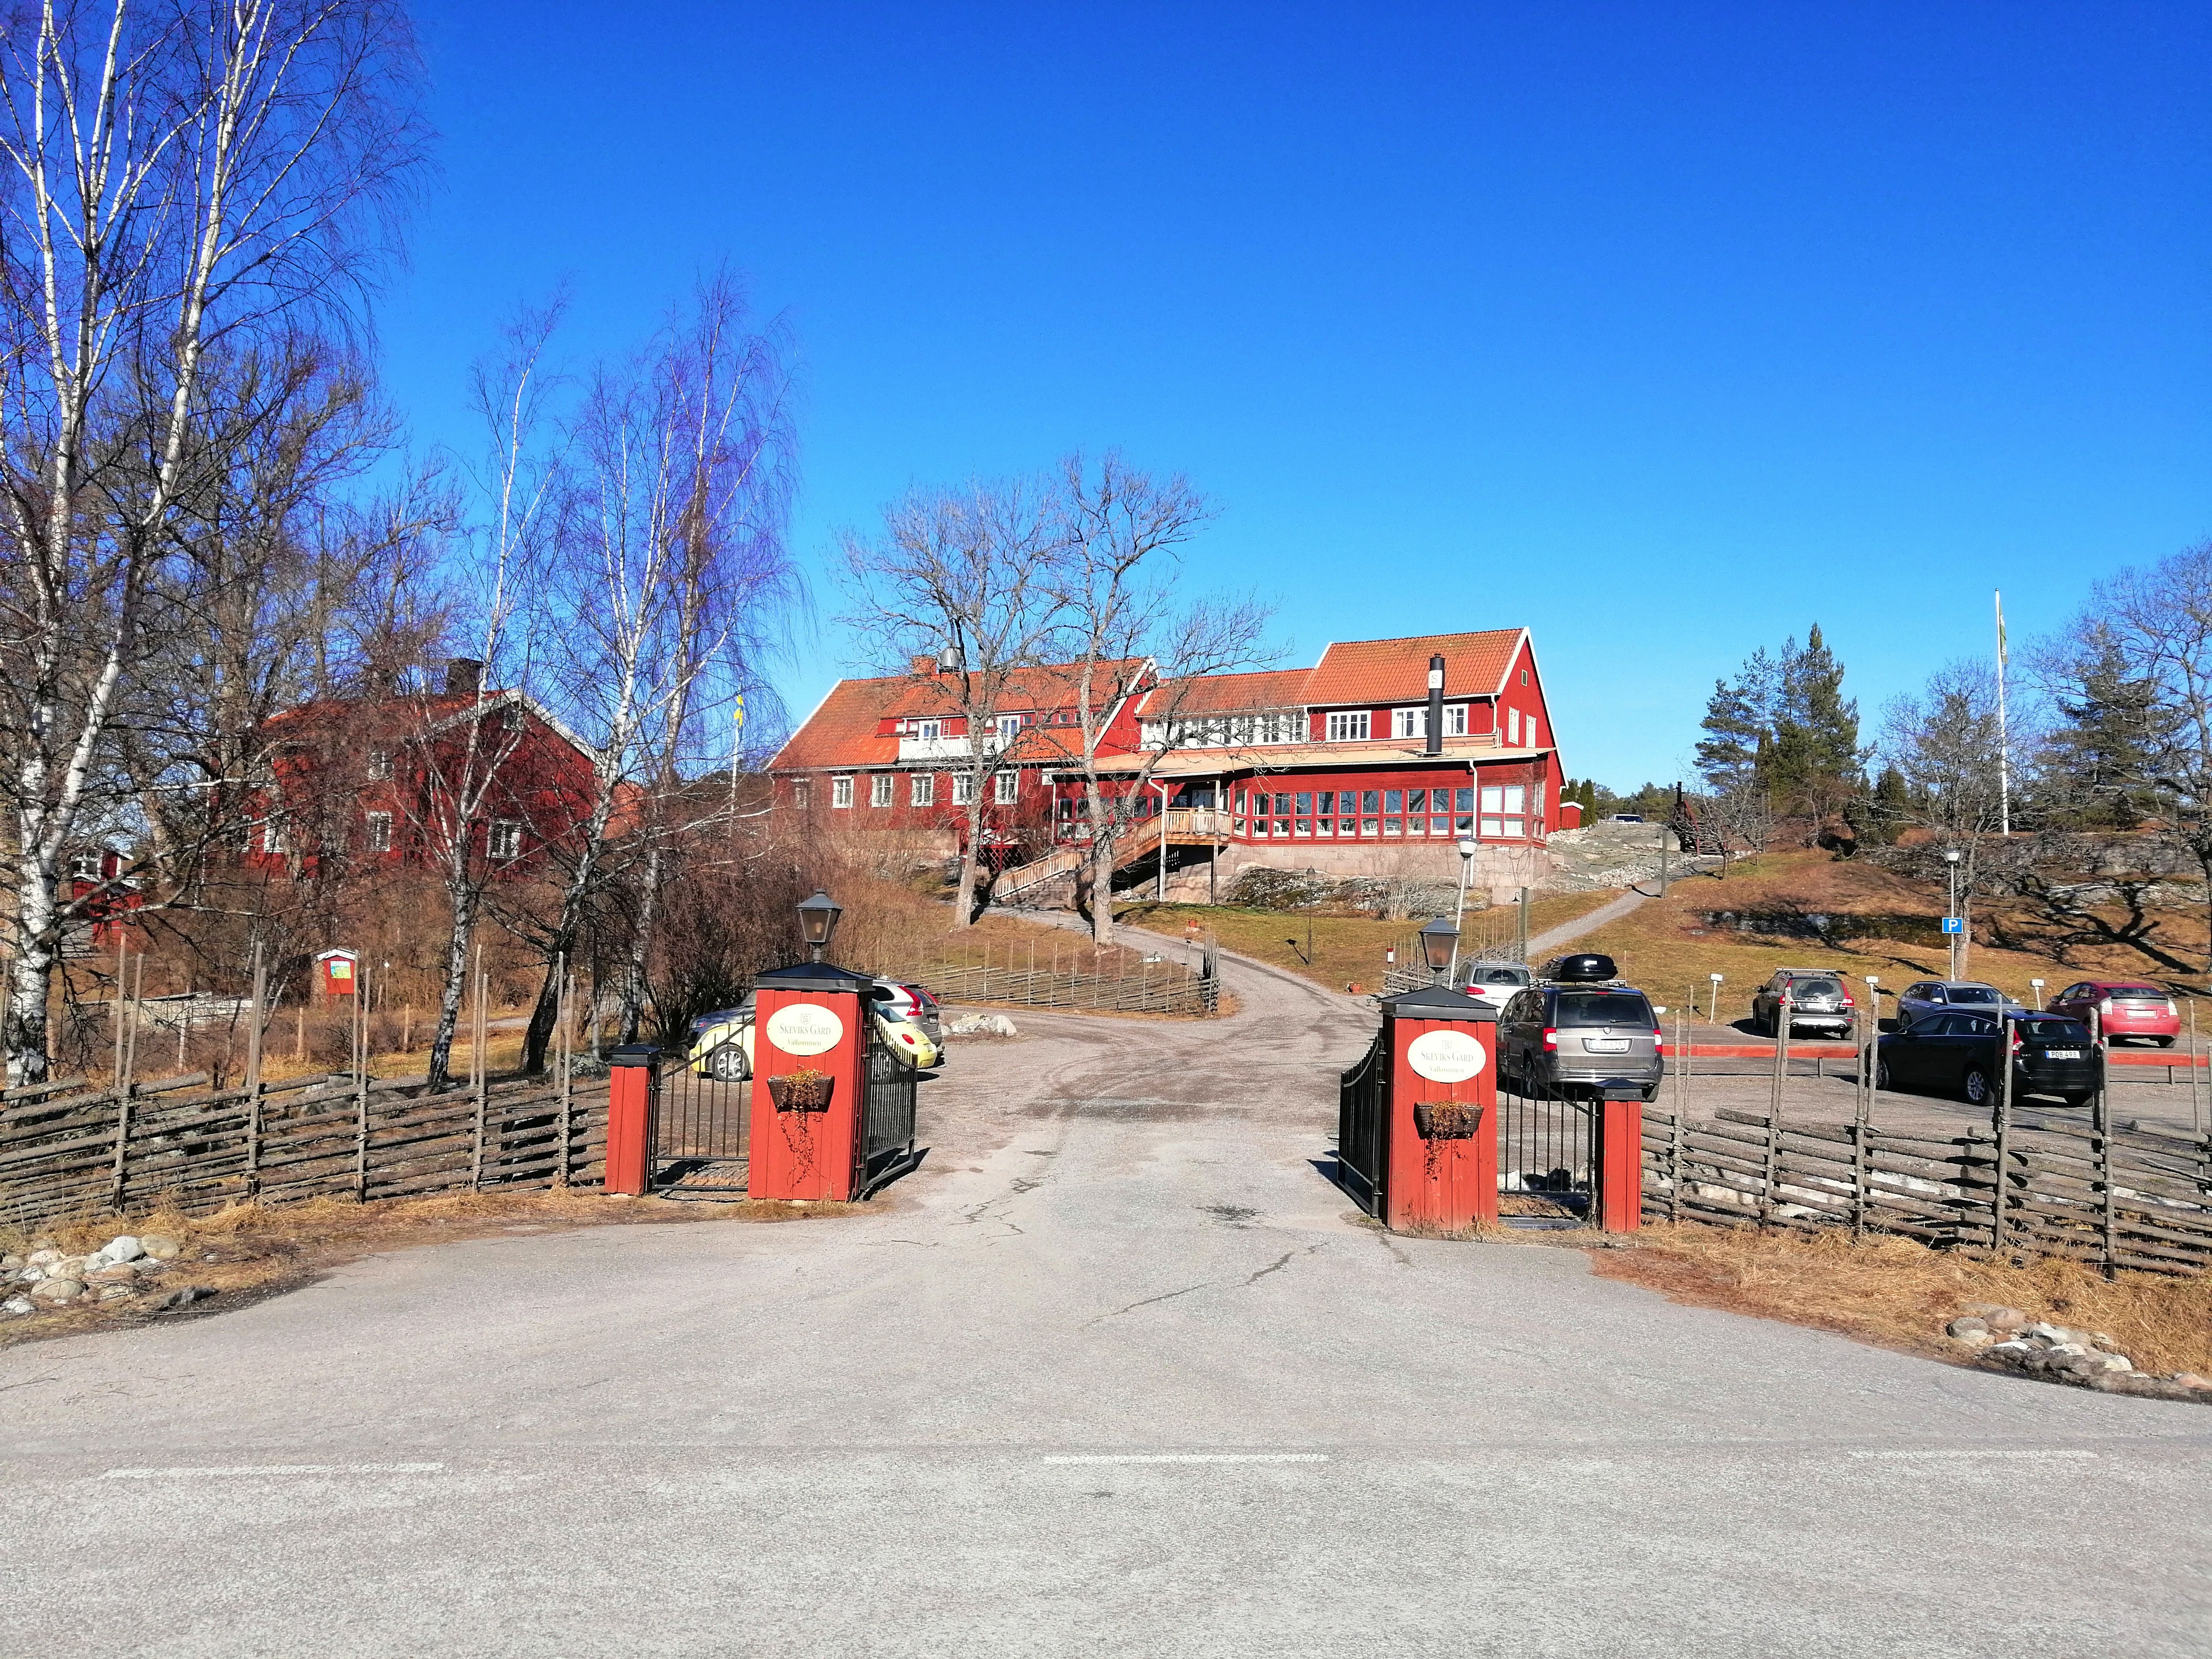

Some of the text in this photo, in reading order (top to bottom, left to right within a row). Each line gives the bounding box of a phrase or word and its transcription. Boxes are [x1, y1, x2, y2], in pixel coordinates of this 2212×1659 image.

[1431, 674, 1437, 683] S
[1948, 919, 1958, 931] P
[780, 1023, 808, 1034] SKEVIKS
[1421, 1051, 1450, 1061] SKEVIKS
